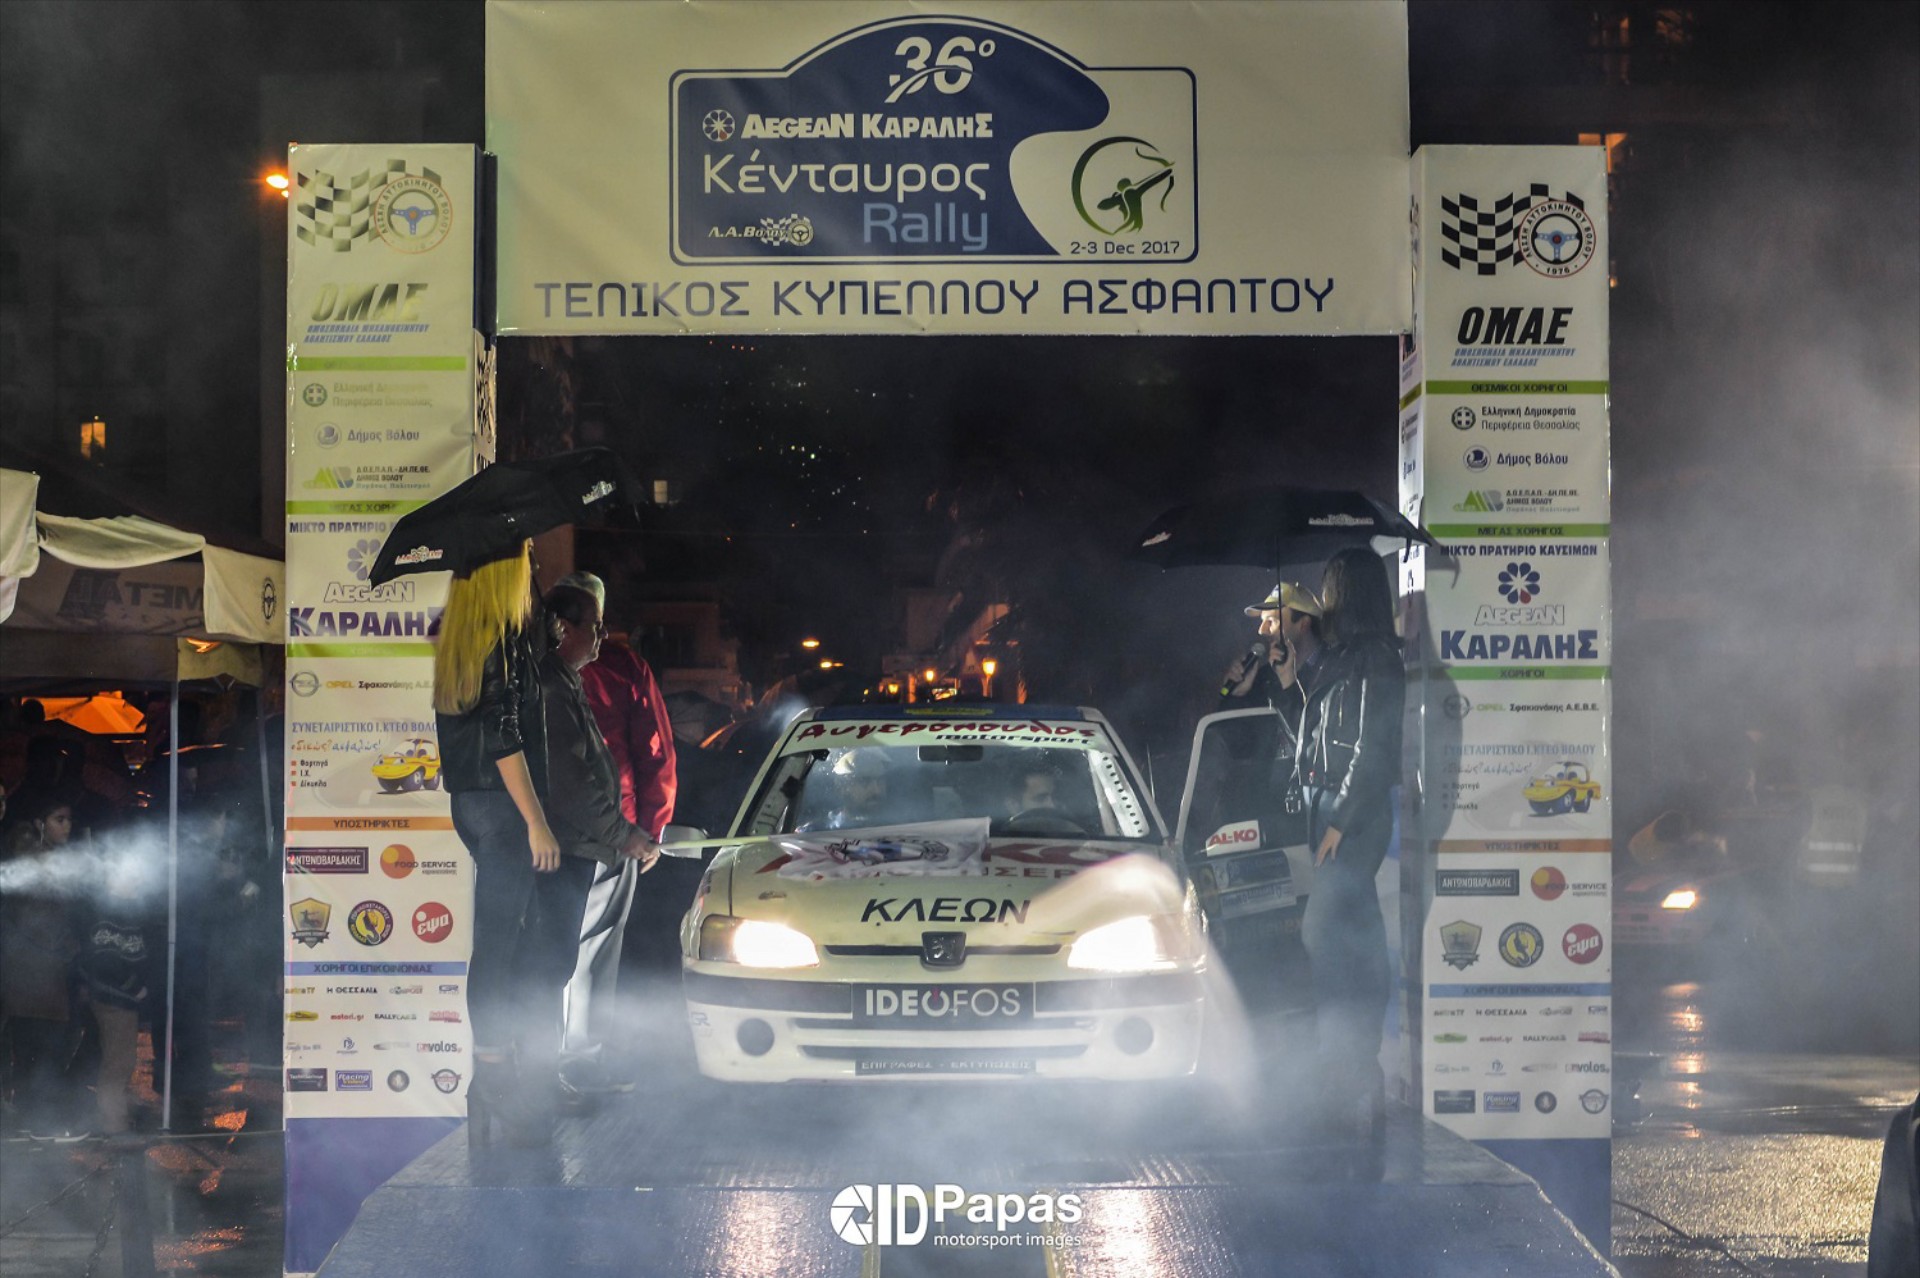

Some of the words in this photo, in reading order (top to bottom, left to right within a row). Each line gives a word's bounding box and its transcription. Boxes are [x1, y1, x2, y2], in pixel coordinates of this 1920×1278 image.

[741, 112, 855, 139] AEGEAN
[861, 112, 994, 139] ΚΑΡΑΛΗΣ
[703, 149, 991, 203] Κένταυρος
[863, 202, 989, 252] Rally
[1070, 241, 1098, 255] 2-3
[1104, 241, 1135, 255] Dec
[1141, 241, 1180, 255] 2017
[1457, 306, 1574, 345] ΟΜΑΕ
[1481, 406, 1522, 417] Ελληνική
[1524, 406, 1577, 417] Δημοκρατία
[1496, 453, 1531, 466] Δήμος
[1535, 453, 1569, 465] Βόλου
[289, 521, 326, 534] ΜΙΚΤΟ
[328, 521, 386, 533] ΠΡΑΤΗΡΙΟ
[1440, 545, 1476, 556] ΜΙΚΤΟ
[1479, 545, 1537, 556] ΠΡΑΤΗΡΙΟ
[1539, 544, 1598, 555] ΚΑΥΣΙΜΩΝ
[323, 581, 415, 603] AEGEAN
[1474, 604, 1565, 626] AEGEAN
[1440, 630, 1599, 660] ΚΑΡΑΛΗΣ
[410, 721, 437, 732] ΒΟΛΟ
[935, 733, 1092, 746] motorsport
[333, 819, 411, 829] ΥΠΟΣΤΗΡΙΚΤΕΣ
[1208, 828, 1259, 847] AL-KO
[288, 854, 362, 865] ΝΤΩΝΟΒΑΡΔΑΚΗΣ
[1571, 882, 1608, 891] SERVICE
[860, 898, 1032, 925] ΚΛΕΩΝ
[865, 988, 1021, 1018] IDEOFOS
